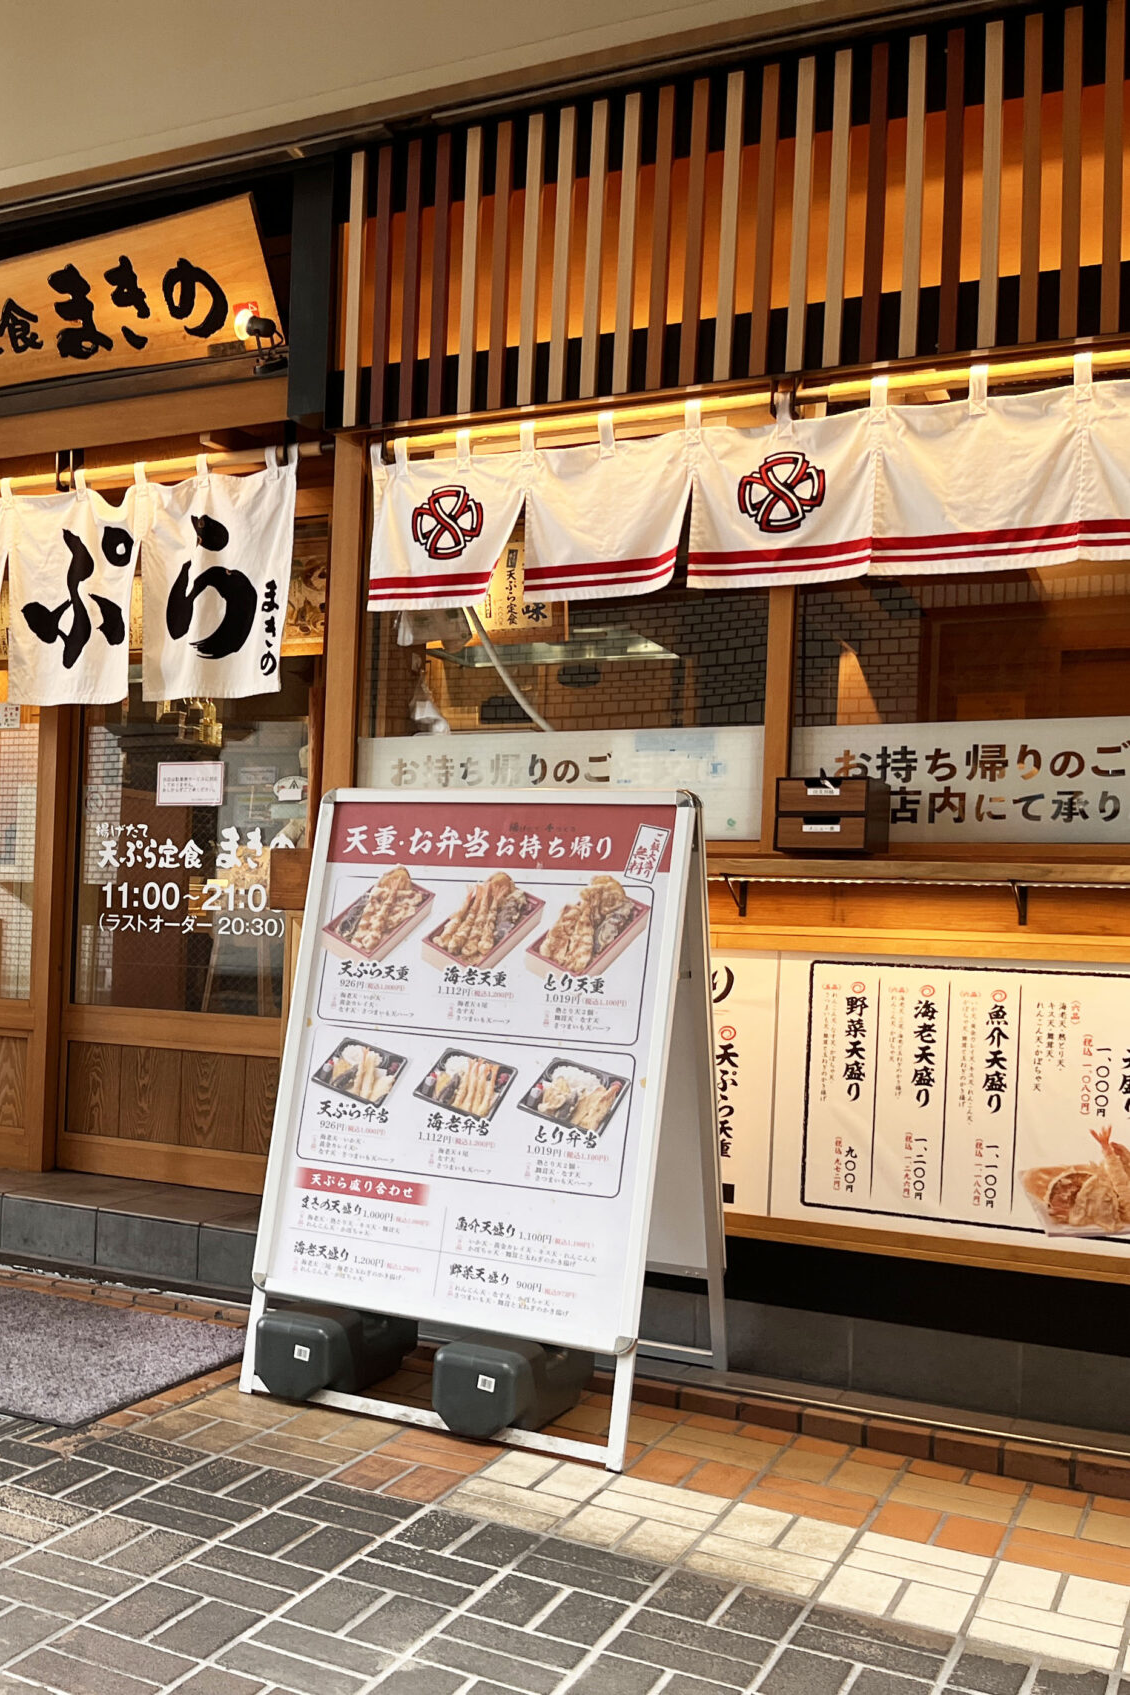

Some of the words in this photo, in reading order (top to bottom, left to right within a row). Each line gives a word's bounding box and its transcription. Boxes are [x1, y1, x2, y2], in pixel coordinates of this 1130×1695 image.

[48, 255, 228, 359] まきの
[259, 579, 280, 676] まきの
[96, 823, 149, 838] 揚げたて
[97, 838, 204, 869] 天ぷら定食
[99, 913, 212, 934] (ラストオーダー
[218, 916, 285, 938] 20:30)
[338, 960, 410, 981] 天ぷら天重
[444, 966, 507, 988] 海老天重
[340, 979, 364, 990] 926円
[437, 986, 471, 997] 1,112円
[544, 973, 605, 994] とり天重
[545, 994, 580, 1005] 1,019円
[842, 996, 869, 1102] 野菜天盛り
[911, 1000, 938, 1108] 海老天盛り
[1083, 1034, 1094, 1056] (税込
[982, 1004, 1010, 1114] 魚介天盛り
[1094, 1048, 1112, 1118] 一、〇〇〇円
[317, 1100, 389, 1124] 天ぷら弁当
[427, 1112, 490, 1136] 海老弁当
[320, 1120, 345, 1132] 926円
[418, 1132, 452, 1144] 1,112円
[535, 1125, 597, 1148] とり弁当
[527, 1145, 561, 1158] 1,019円
[844, 1146, 858, 1193] 九〇〇円
[913, 1138, 928, 1200] 一、二〇〇円
[984, 1145, 1000, 1208] 一、一〇〇円
[310, 1173, 414, 1199] 天ぷら盛り合わせ
[301, 1195, 362, 1217] まきの天盛り
[362, 1210, 394, 1222] 1,000円
[455, 1216, 516, 1239] 魚介天盛り
[518, 1231, 553, 1244] 1,100円
[294, 1240, 349, 1262] 海老天盛り
[353, 1255, 385, 1268] 1,200円
[449, 1263, 509, 1285] 野菜天盛り
[516, 1280, 543, 1293] 900円
